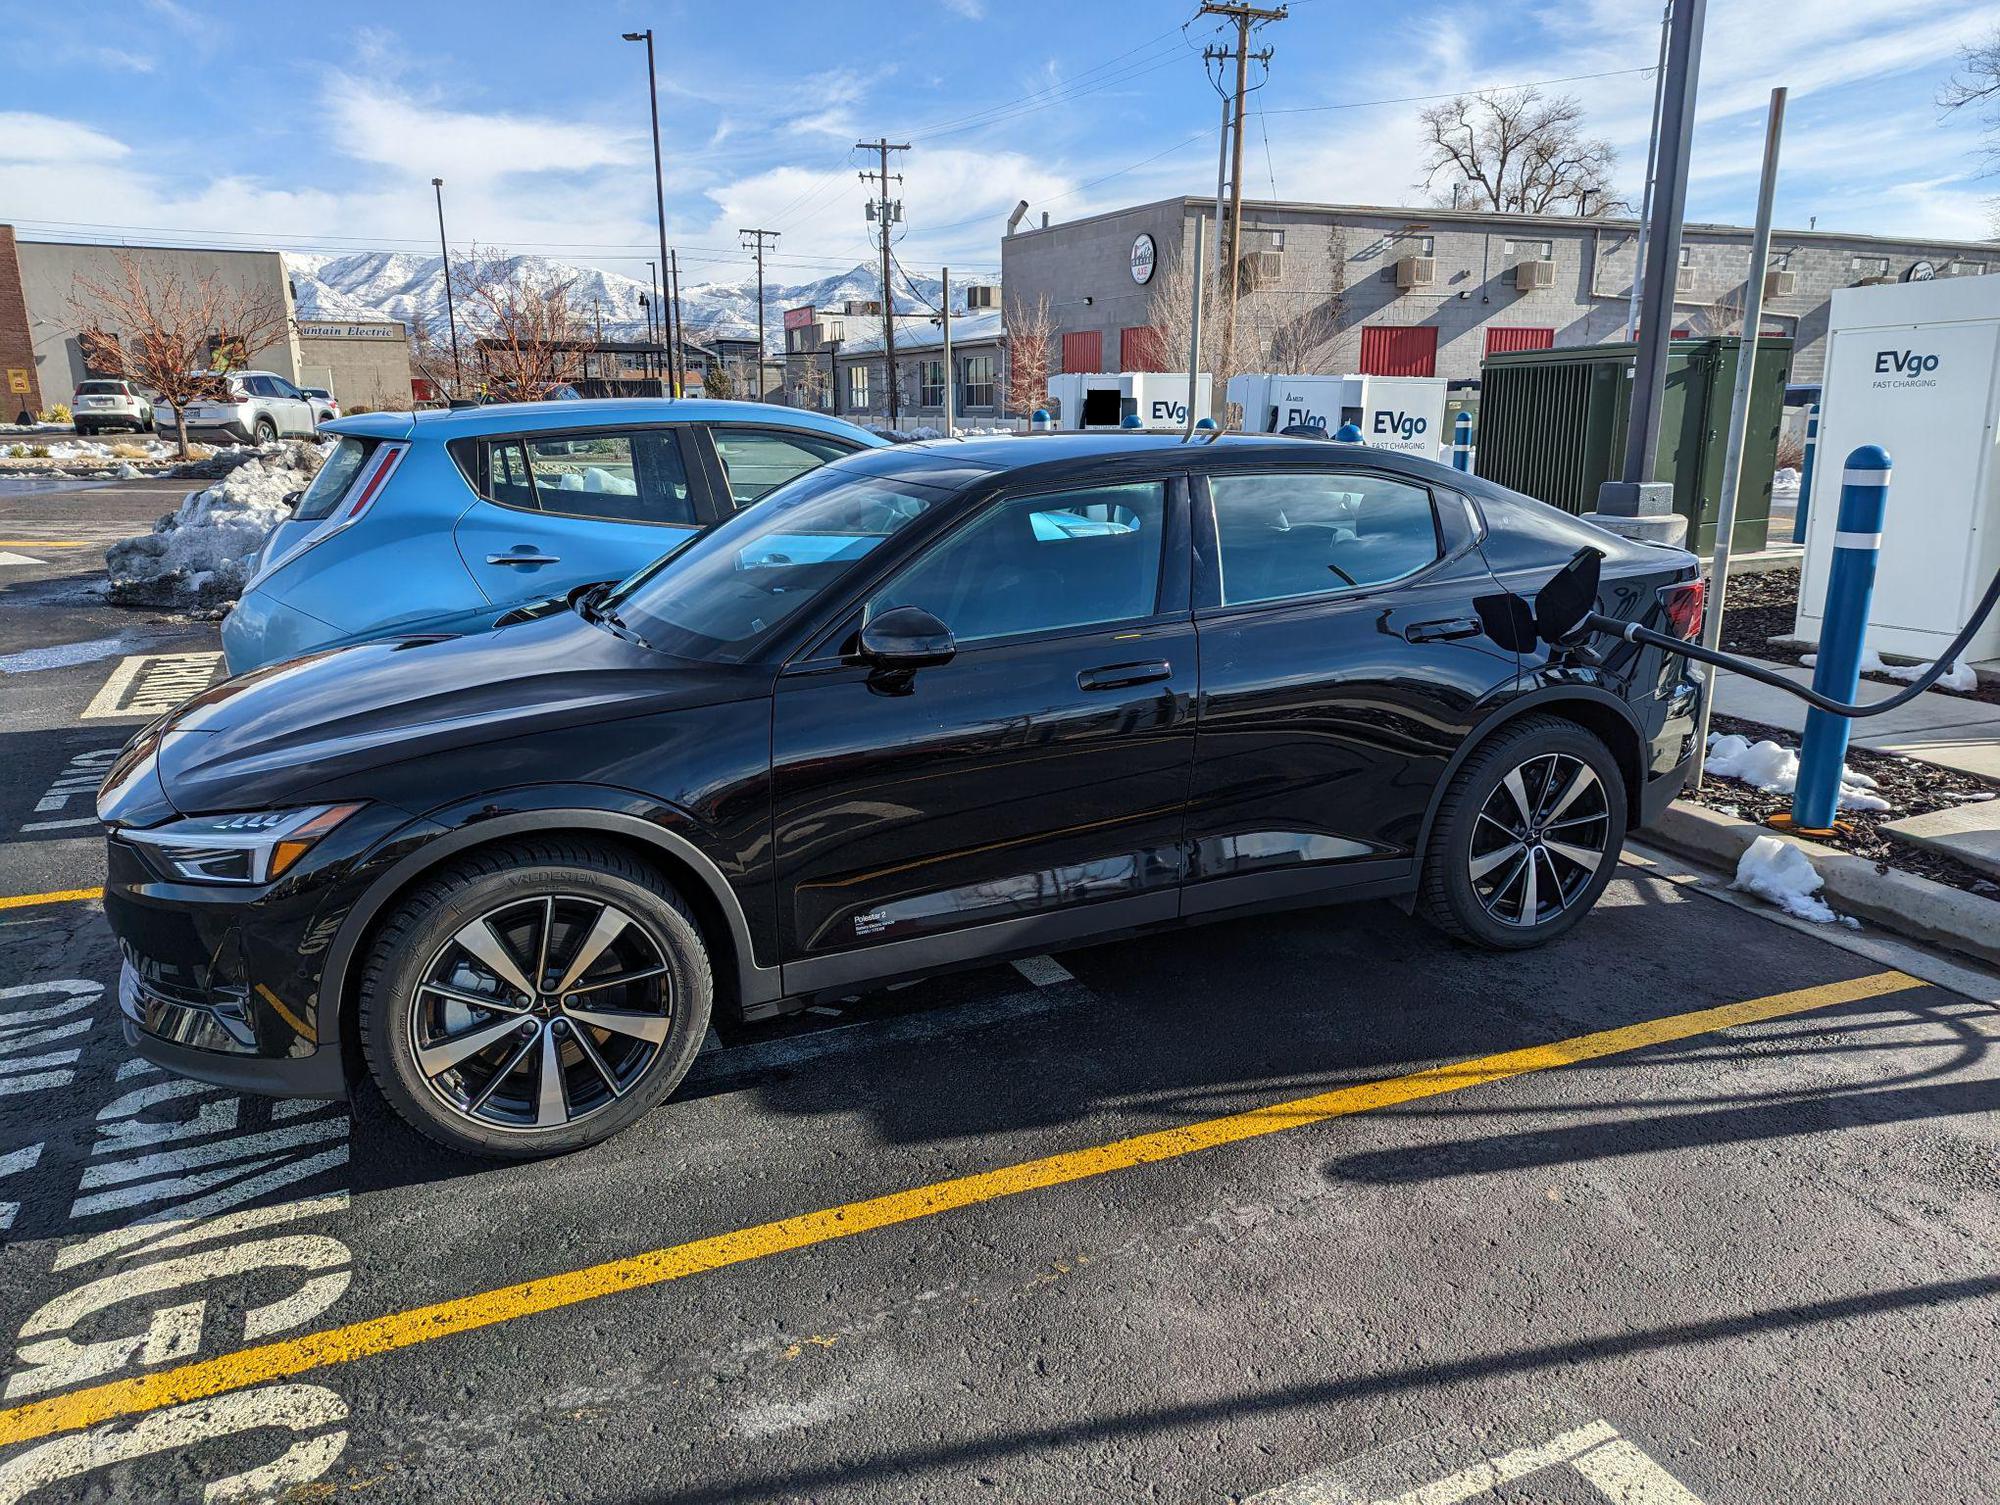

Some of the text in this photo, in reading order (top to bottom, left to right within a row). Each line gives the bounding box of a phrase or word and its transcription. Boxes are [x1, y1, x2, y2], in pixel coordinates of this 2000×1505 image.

[303, 326, 392, 337] untain Electric
[1875, 350, 1939, 378] EVgo
[1893, 380, 1936, 388] CHARGING
[1152, 401, 1190, 424] EVg
[1374, 411, 1427, 440] EVgo
[854, 914, 880, 923] Polestar
